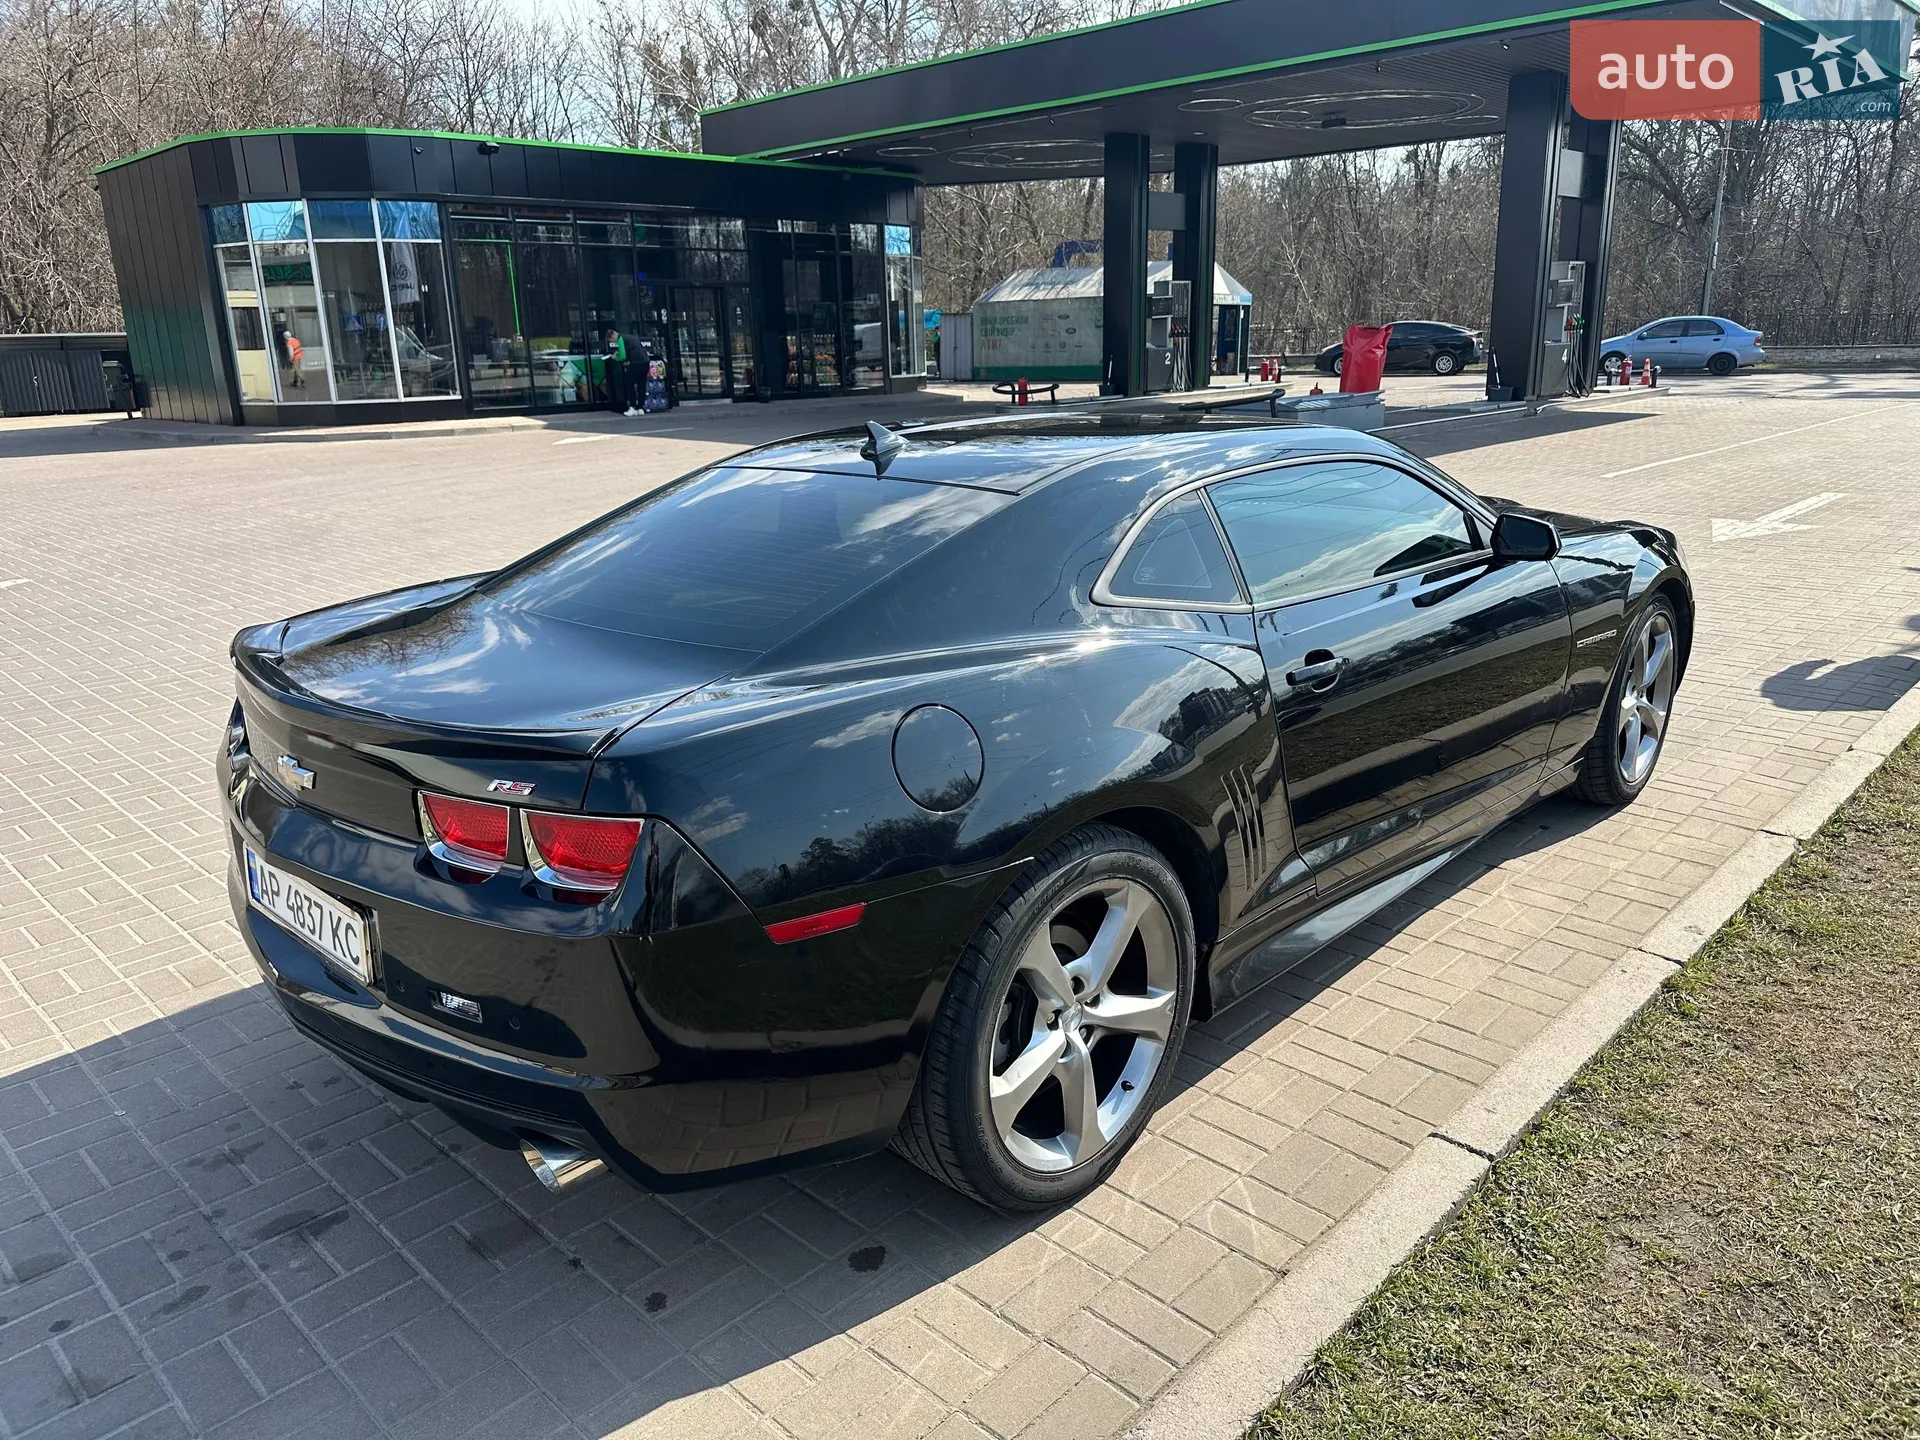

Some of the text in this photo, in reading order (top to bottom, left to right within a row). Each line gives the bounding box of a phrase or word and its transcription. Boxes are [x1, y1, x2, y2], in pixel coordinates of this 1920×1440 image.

[1165, 352, 1171, 365] 2
[1561, 348, 1568, 363] 4
[1577, 629, 1617, 648] CAMARO
[486, 778, 536, 796] RS
[260, 864, 360, 965] AP 4837 KC
